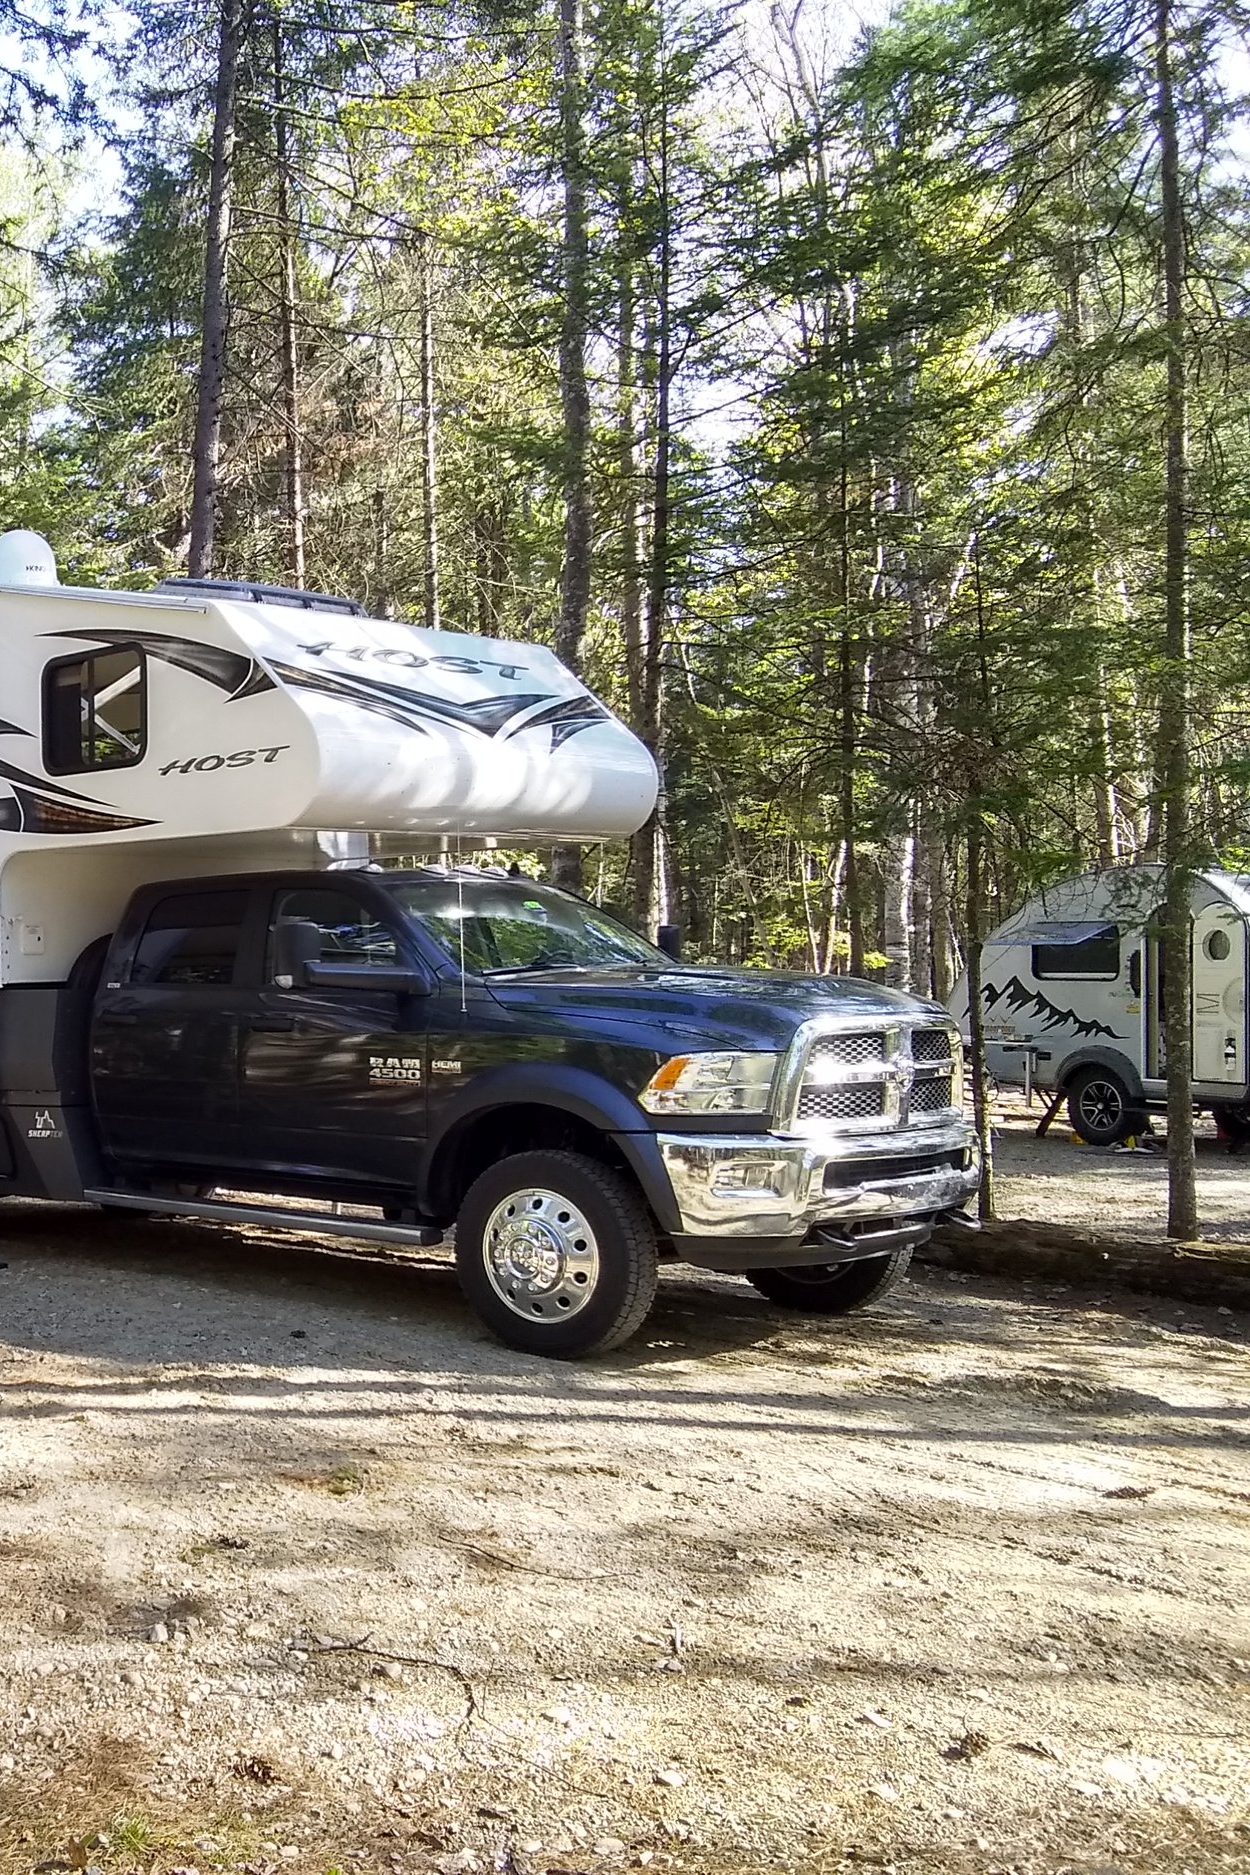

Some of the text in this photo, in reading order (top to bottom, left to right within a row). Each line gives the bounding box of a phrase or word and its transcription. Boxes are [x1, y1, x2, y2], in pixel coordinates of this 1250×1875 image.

[296, 640, 530, 681] HOST
[157, 745, 291, 776] HOST
[369, 1057, 421, 1069] RAM
[431, 1060, 461, 1069] HEMI
[368, 1068, 421, 1079] 4500
